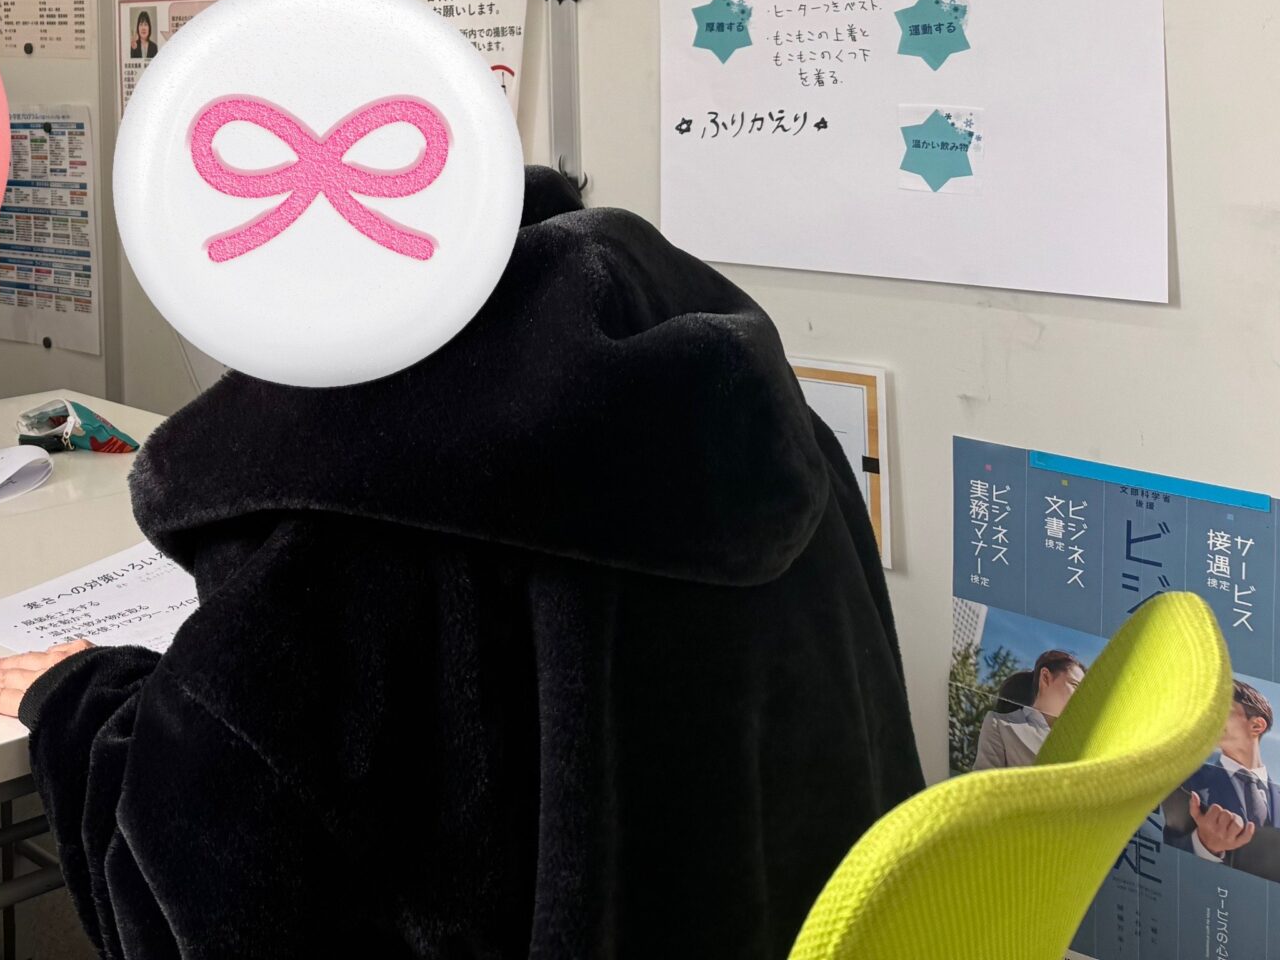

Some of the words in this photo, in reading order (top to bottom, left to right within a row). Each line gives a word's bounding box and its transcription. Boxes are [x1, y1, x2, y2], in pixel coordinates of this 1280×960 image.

[704, 22, 746, 33] 厚着する
[908, 21, 957, 36] 運動する
[701, 109, 808, 139] ふりかえり
[911, 139, 970, 153] 温かい飲み物
[1119, 484, 1171, 504] 文部科学省
[970, 479, 989, 574] 実務マナー
[991, 483, 1011, 565] ビジネス
[1044, 495, 1065, 539] 文書
[1045, 539, 1065, 552] 検定
[1067, 499, 1088, 588] ビジネス
[1206, 529, 1231, 579] 接遇
[970, 575, 990, 588] 検定
[1207, 578, 1231, 591] 検定
[1233, 535, 1257, 632] サービス
